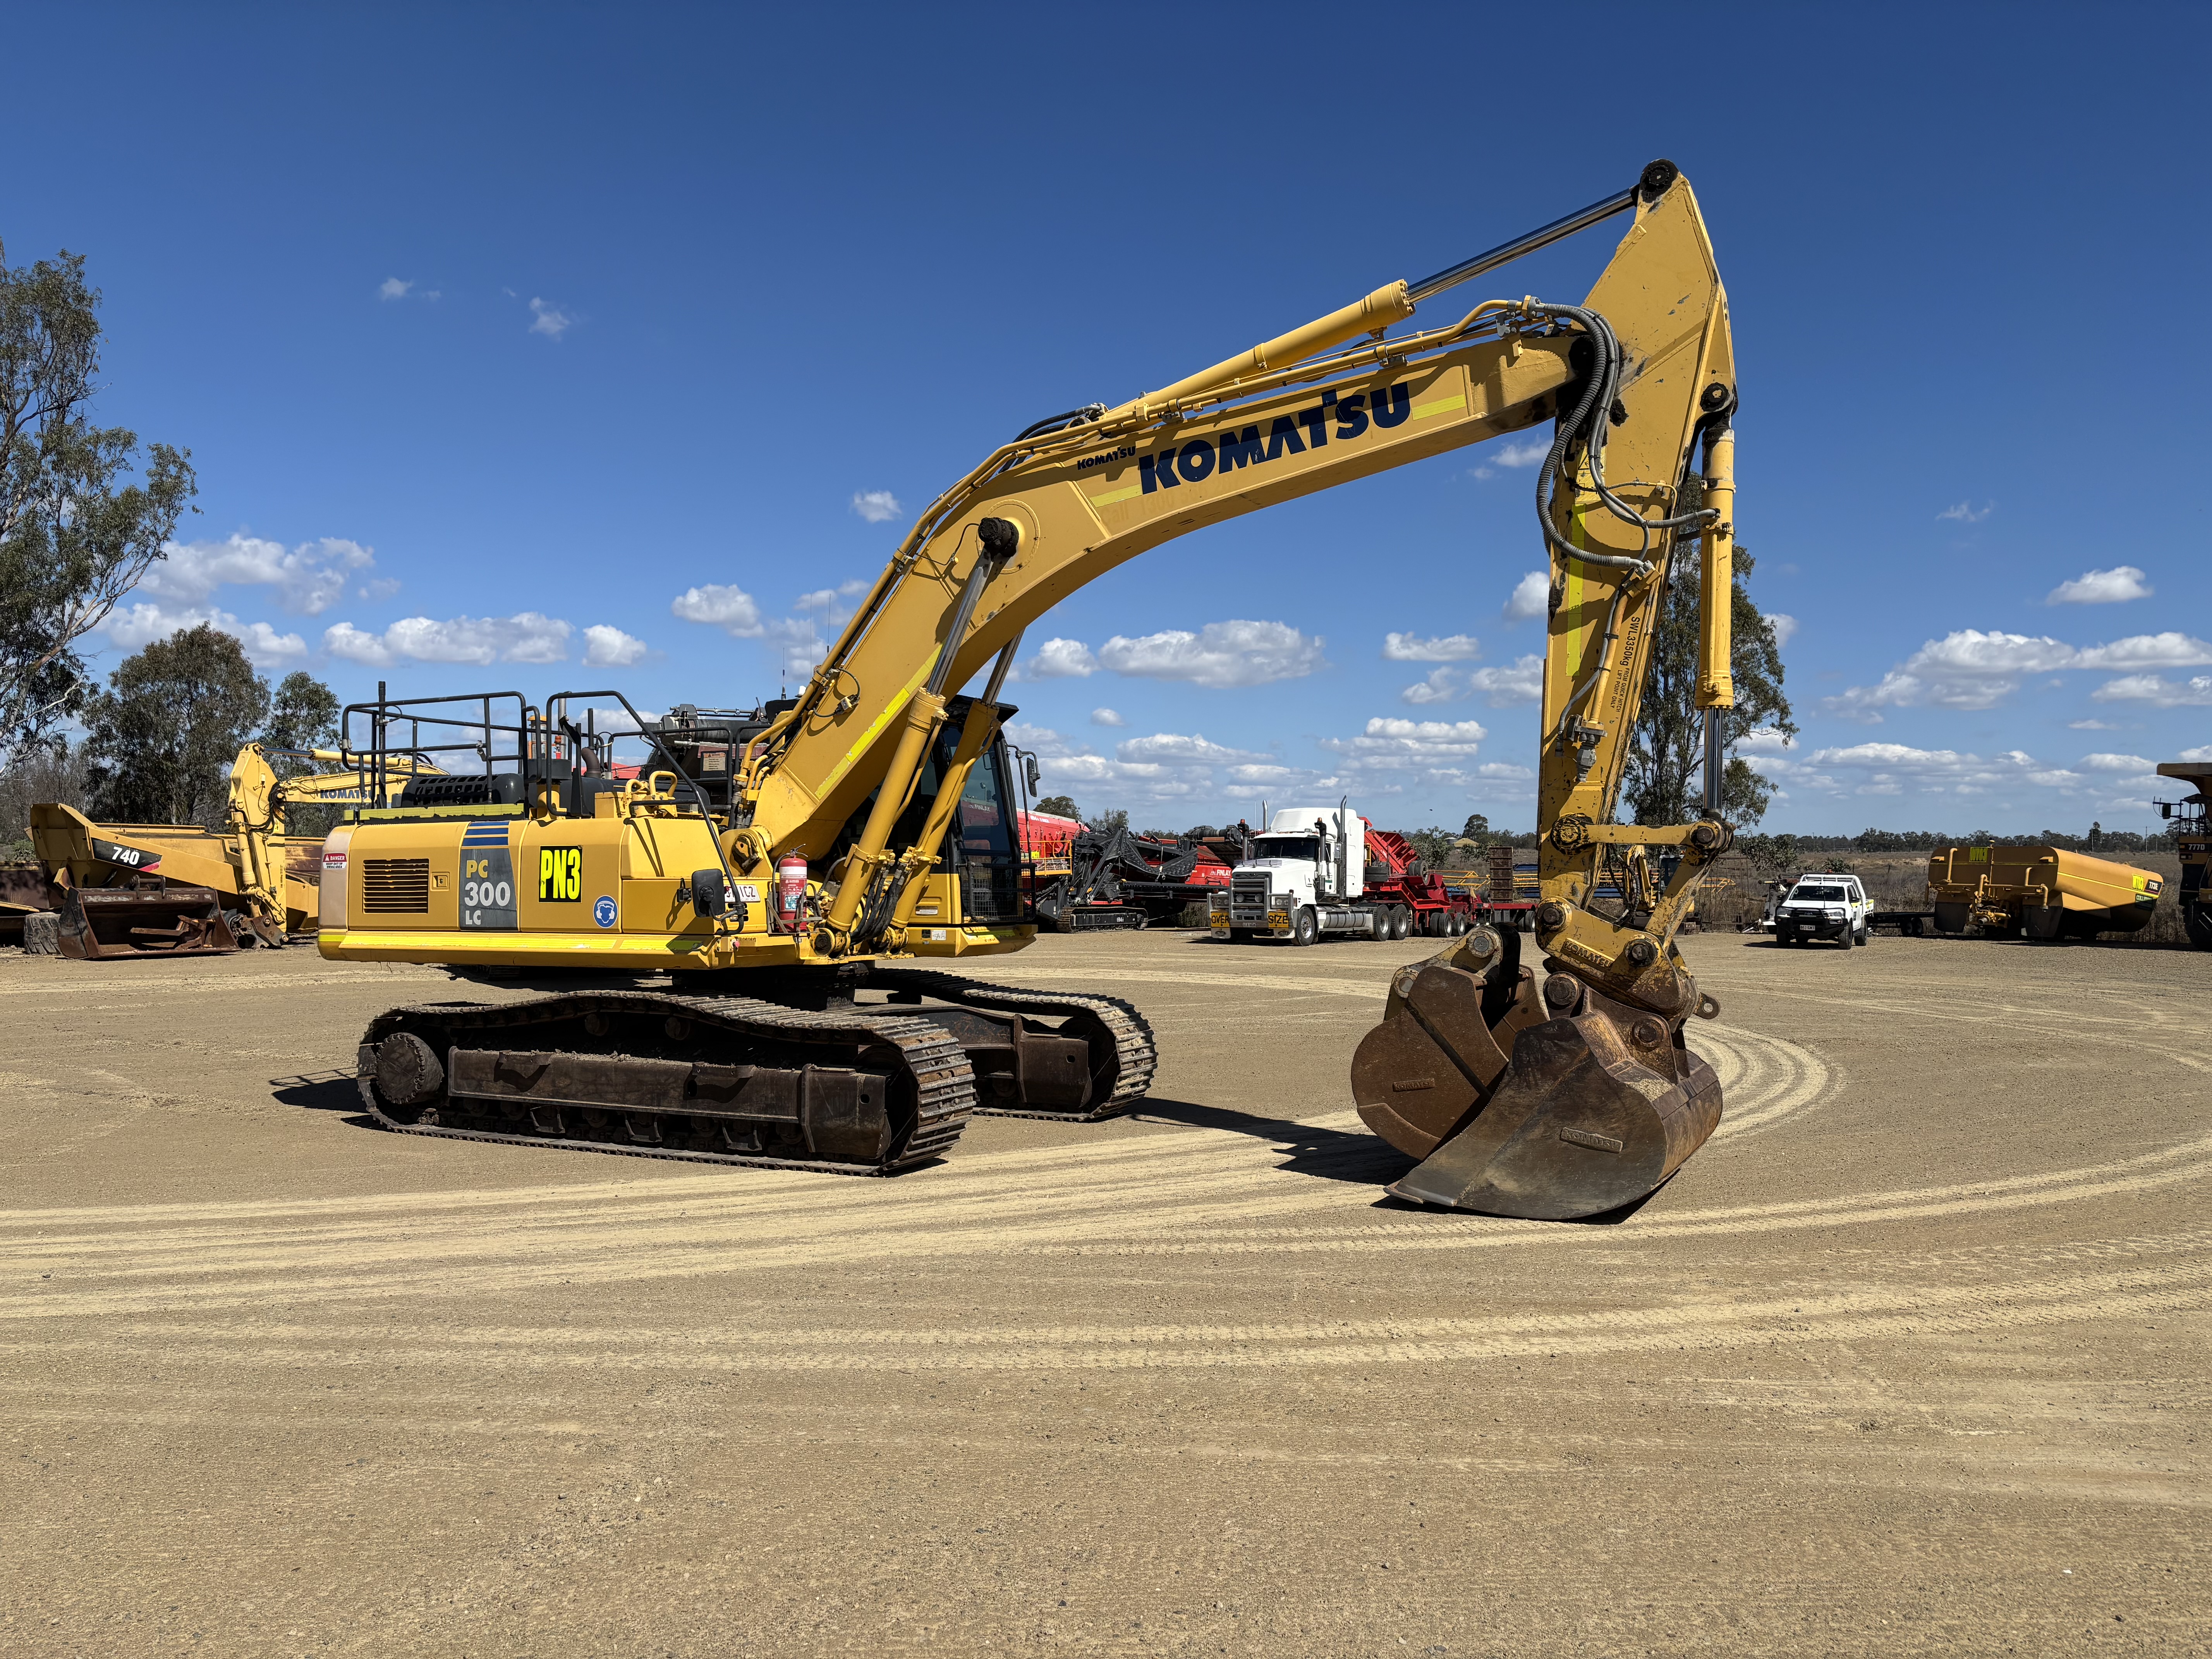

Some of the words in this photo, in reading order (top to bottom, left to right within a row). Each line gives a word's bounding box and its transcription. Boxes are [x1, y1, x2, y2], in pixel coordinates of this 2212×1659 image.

[1140, 381, 1411, 495] KOMATSU
[1077, 446, 1135, 470] KOMATSU
[112, 846, 140, 865] 740
[466, 860, 488, 878] PC
[540, 849, 580, 900] PN3
[464, 882, 510, 906] 300
[465, 910, 481, 925] LC
[1211, 915, 1229, 924] OVER
[1268, 915, 1288, 924] SIZE
[1564, 941, 1613, 967] KOMATSU
